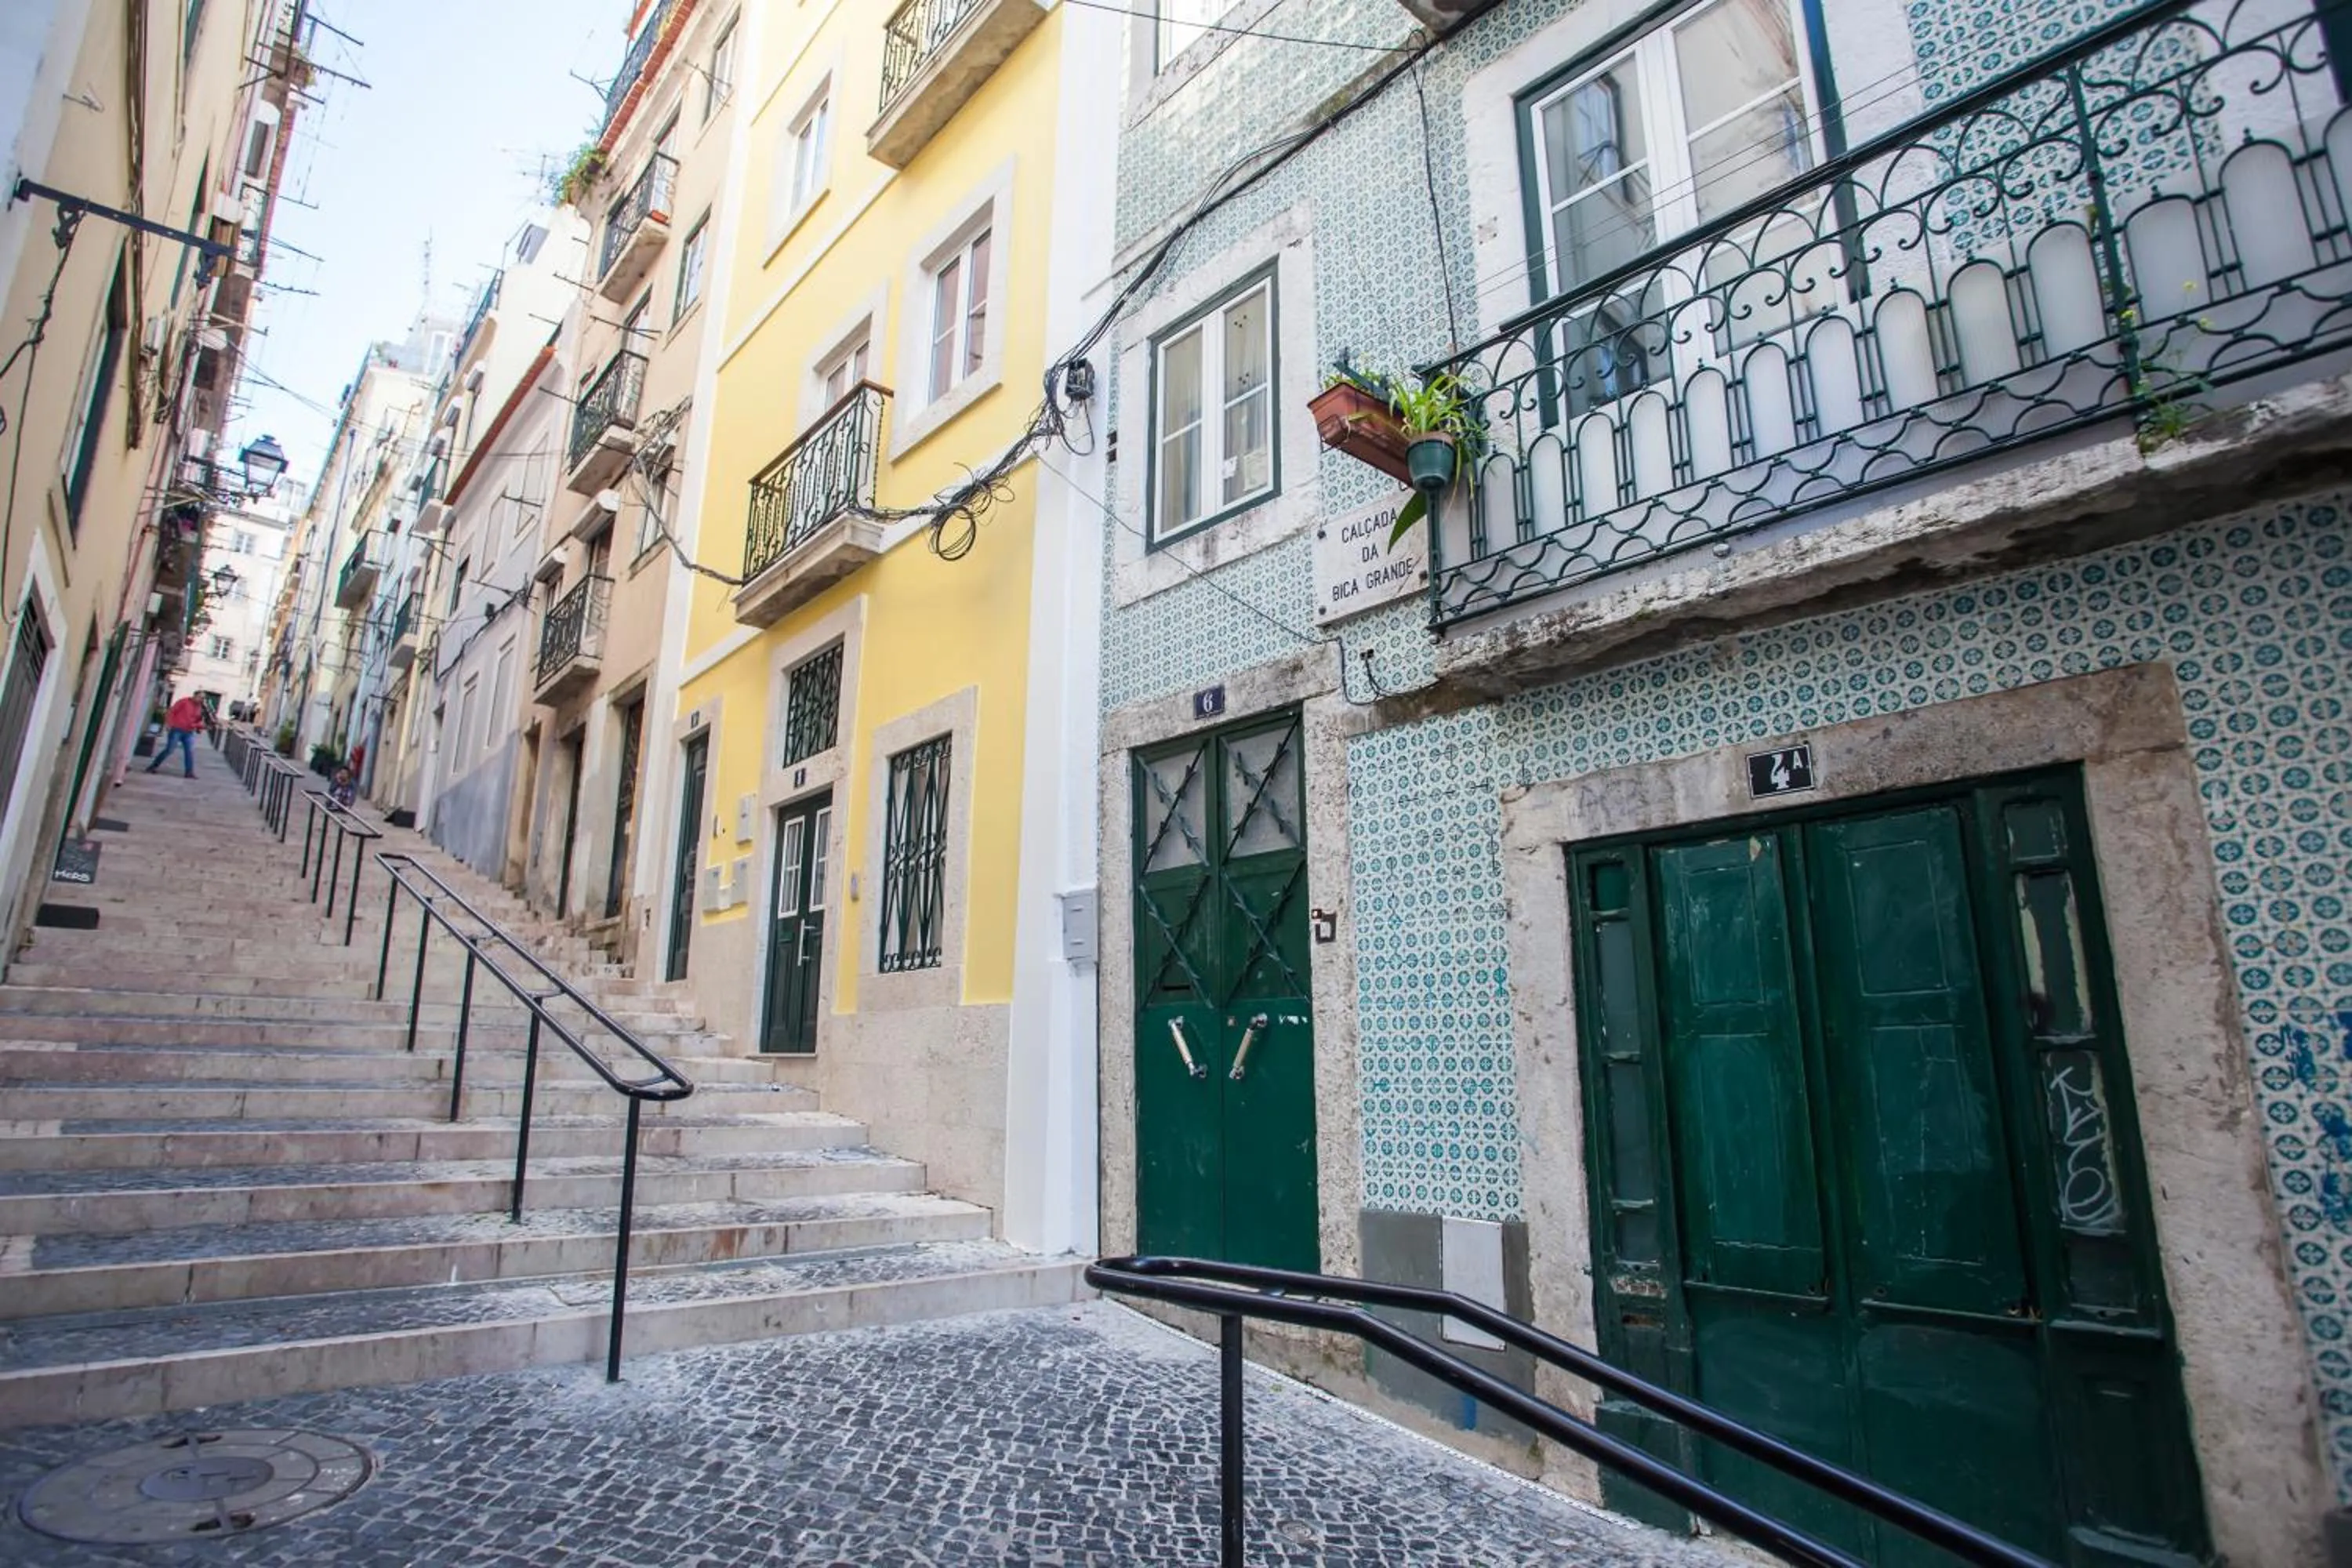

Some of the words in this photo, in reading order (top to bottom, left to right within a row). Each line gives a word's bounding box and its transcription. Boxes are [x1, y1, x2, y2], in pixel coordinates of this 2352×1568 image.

[1341, 508, 1398, 543] CALÇADA
[1362, 544, 1380, 562] DA
[1333, 579, 1359, 601] BICA
[1367, 558, 1414, 588] GRANDE
[1203, 693, 1213, 712] 6
